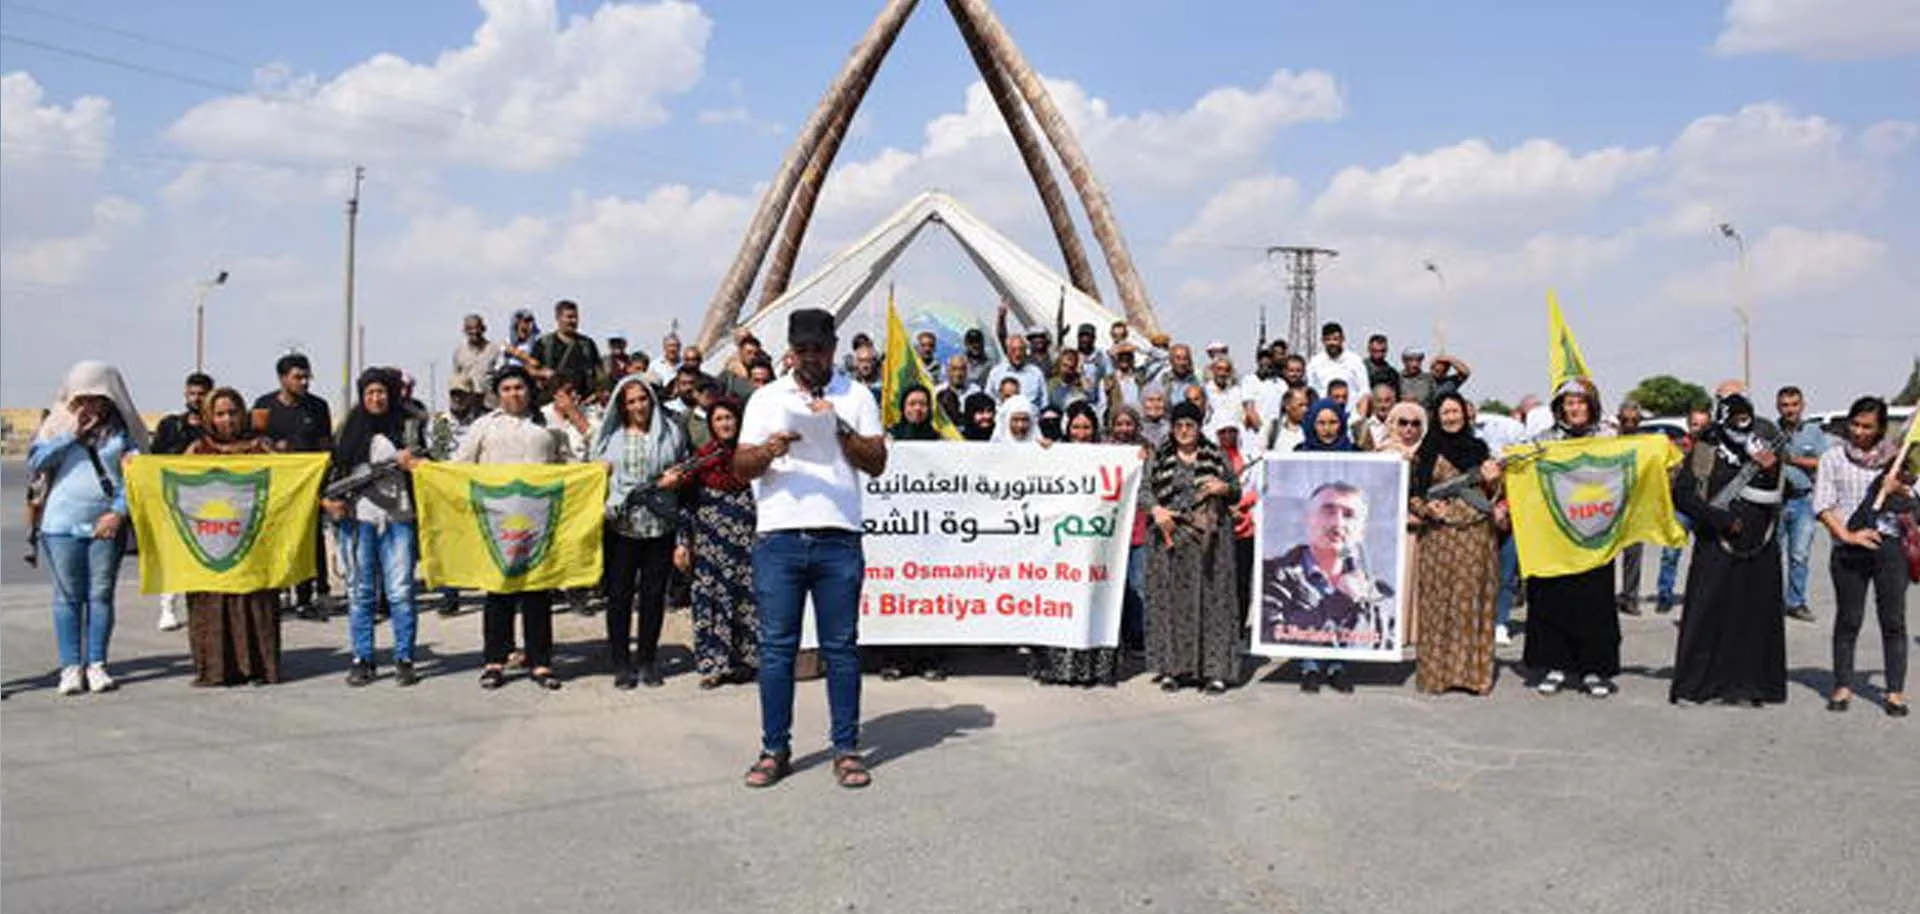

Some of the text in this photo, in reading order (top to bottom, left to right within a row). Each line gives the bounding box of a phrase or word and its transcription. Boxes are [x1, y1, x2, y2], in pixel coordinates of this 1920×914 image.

[1100, 464, 1122, 502] لا
[861, 507, 929, 535] الشع
[1053, 507, 1119, 546] نعم
[902, 561, 1011, 583] Osmaniya
[1017, 561, 1048, 580] No
[880, 593, 987, 620] Biratiya
[996, 593, 1073, 619] Gelan
